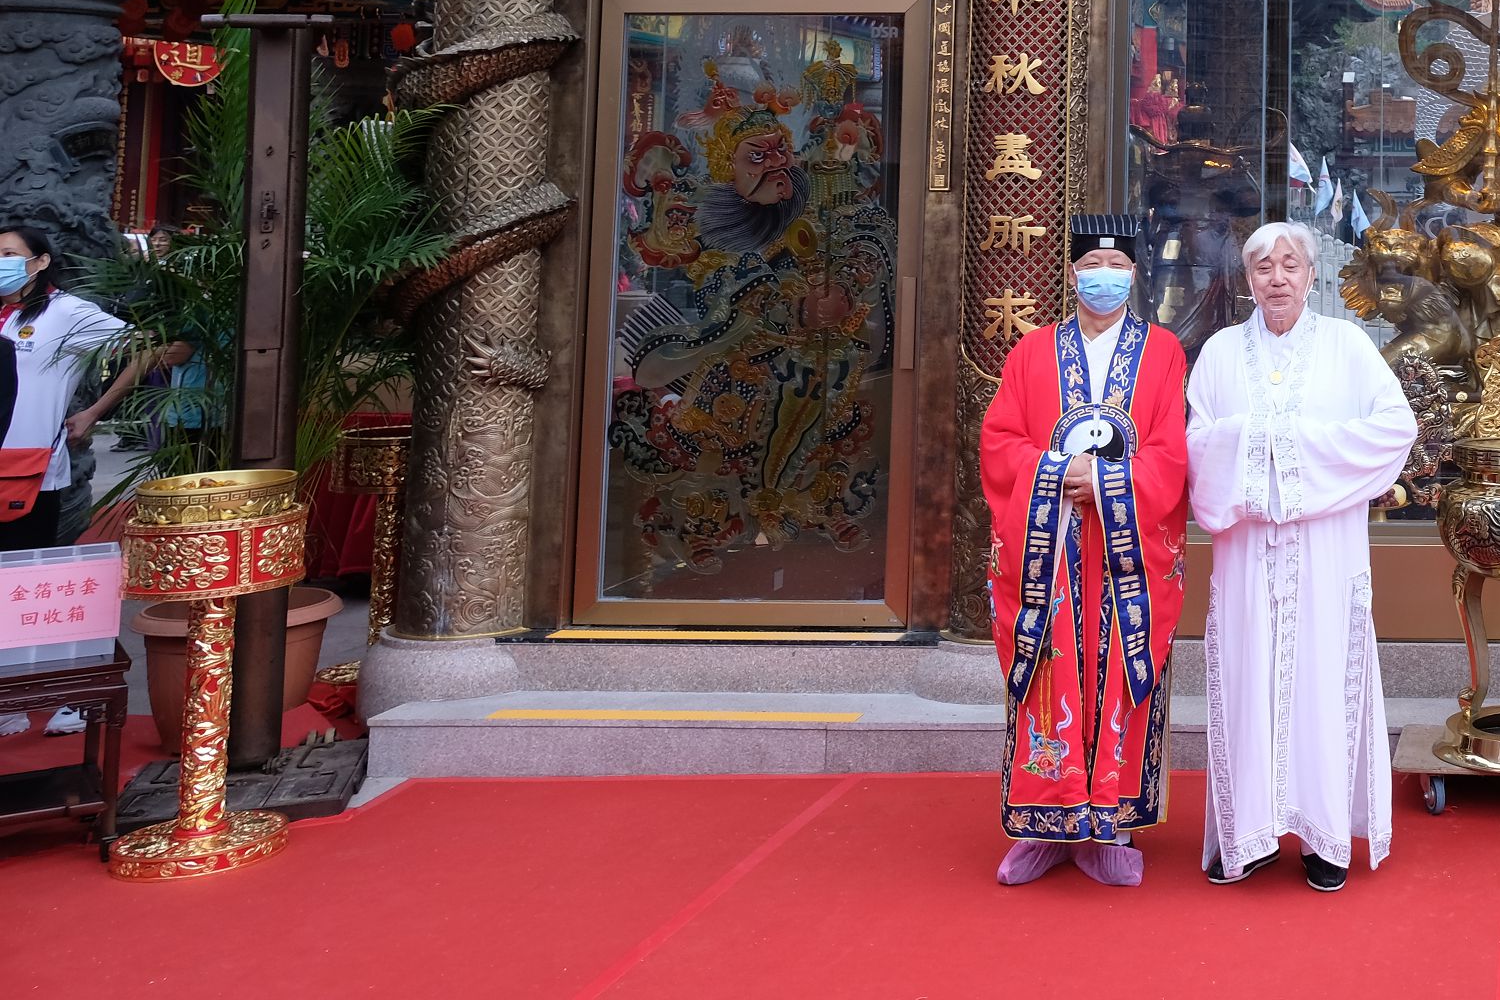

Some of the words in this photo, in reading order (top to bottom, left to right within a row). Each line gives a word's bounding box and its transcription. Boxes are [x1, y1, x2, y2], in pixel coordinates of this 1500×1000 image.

[871, 26, 899, 39] DSA
[9, 577, 100, 602] 金箔咭套
[21, 604, 86, 626] 回收箱
